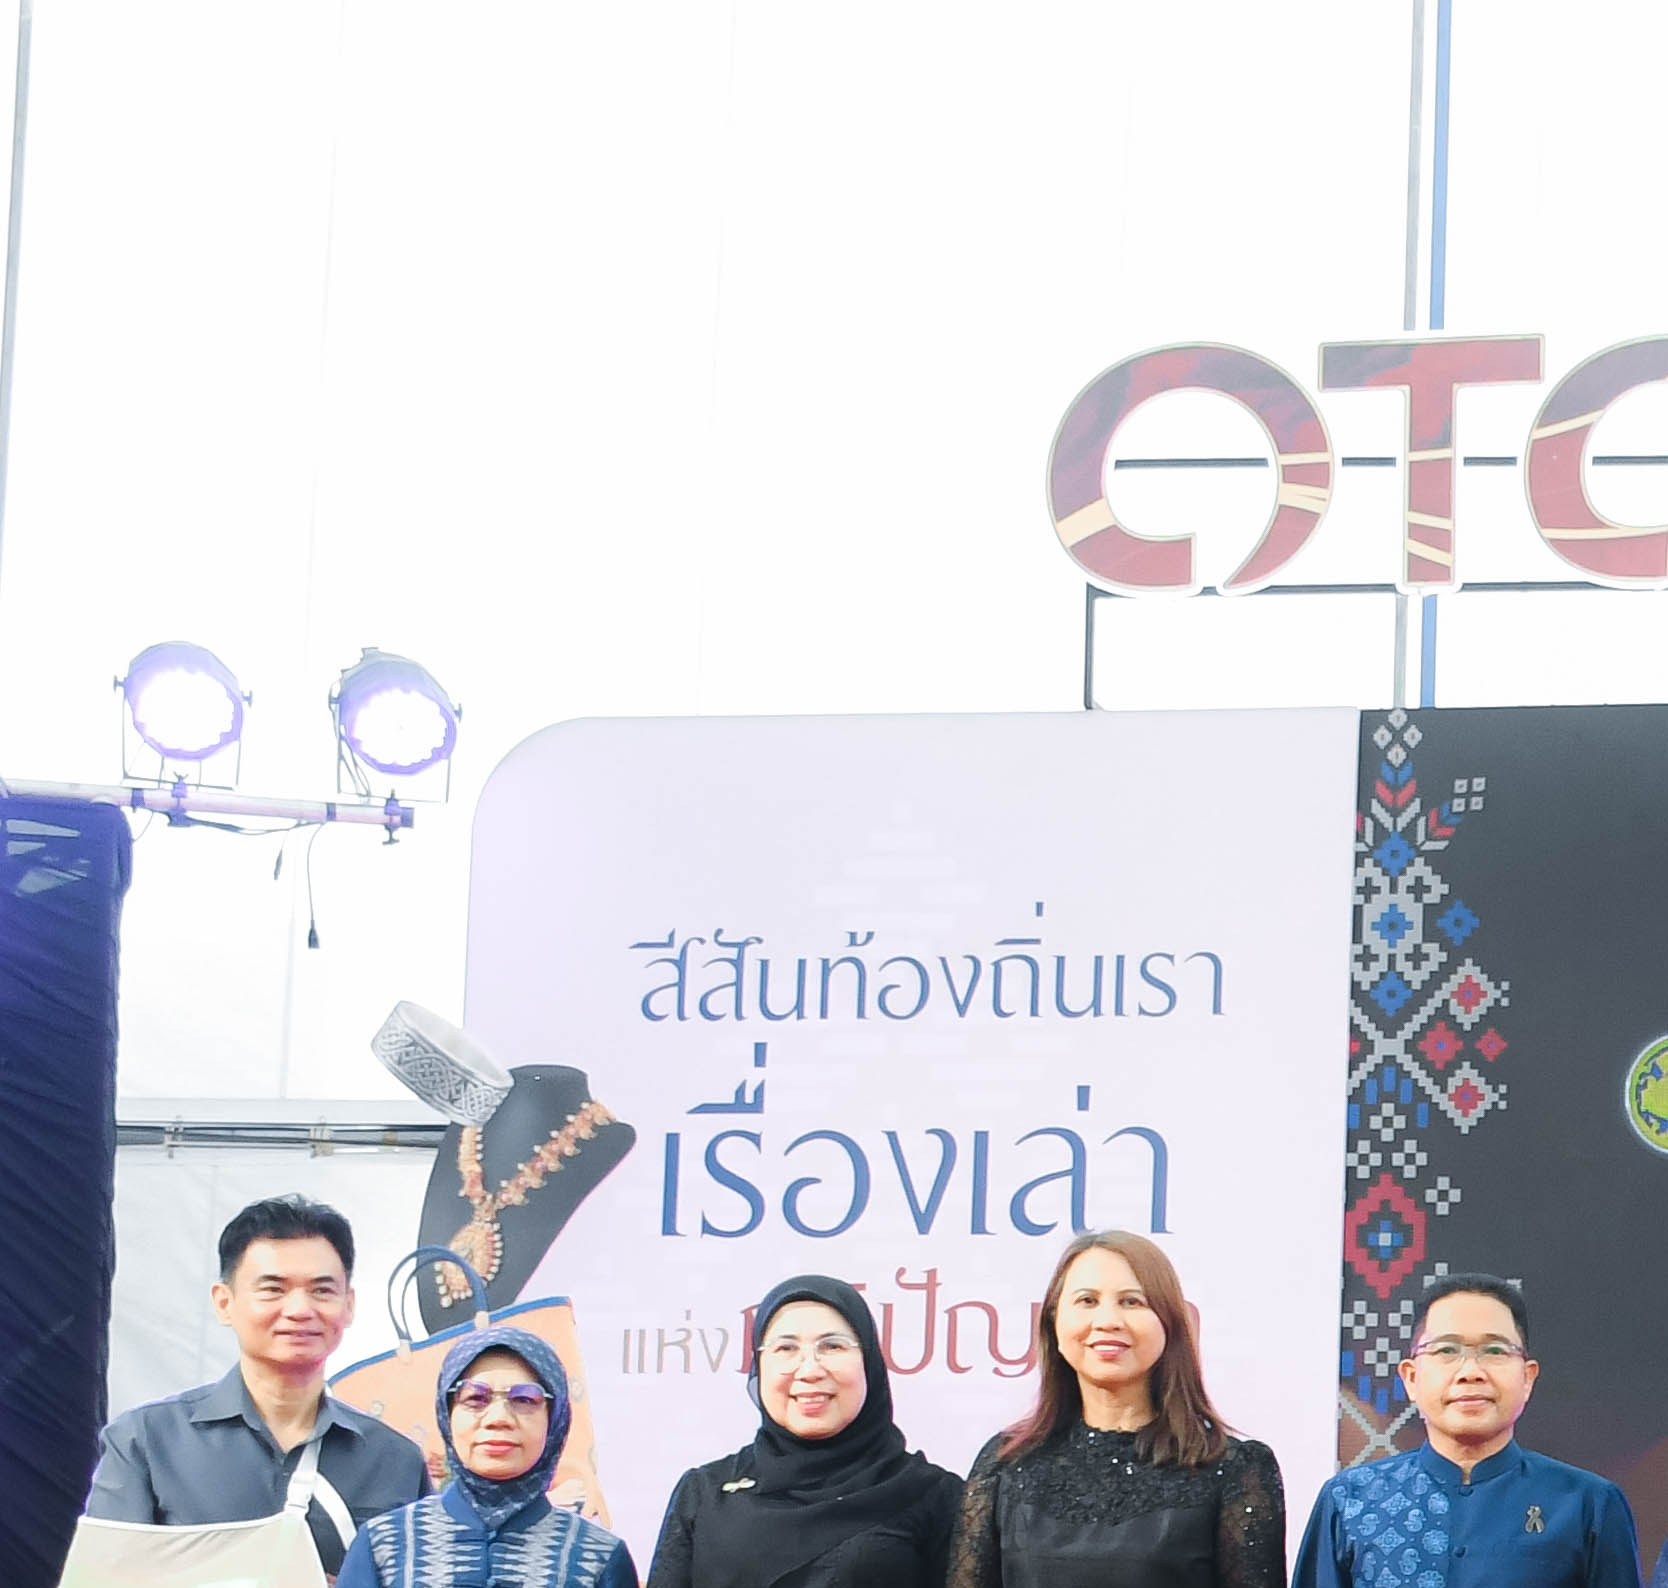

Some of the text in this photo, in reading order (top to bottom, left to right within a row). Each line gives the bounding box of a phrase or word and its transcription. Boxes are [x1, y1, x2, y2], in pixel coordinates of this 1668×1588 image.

[628, 901, 1226, 1021] สีสันท้องถิ่นเรา
[660, 1042, 1175, 1239] เรื่องเล่า
